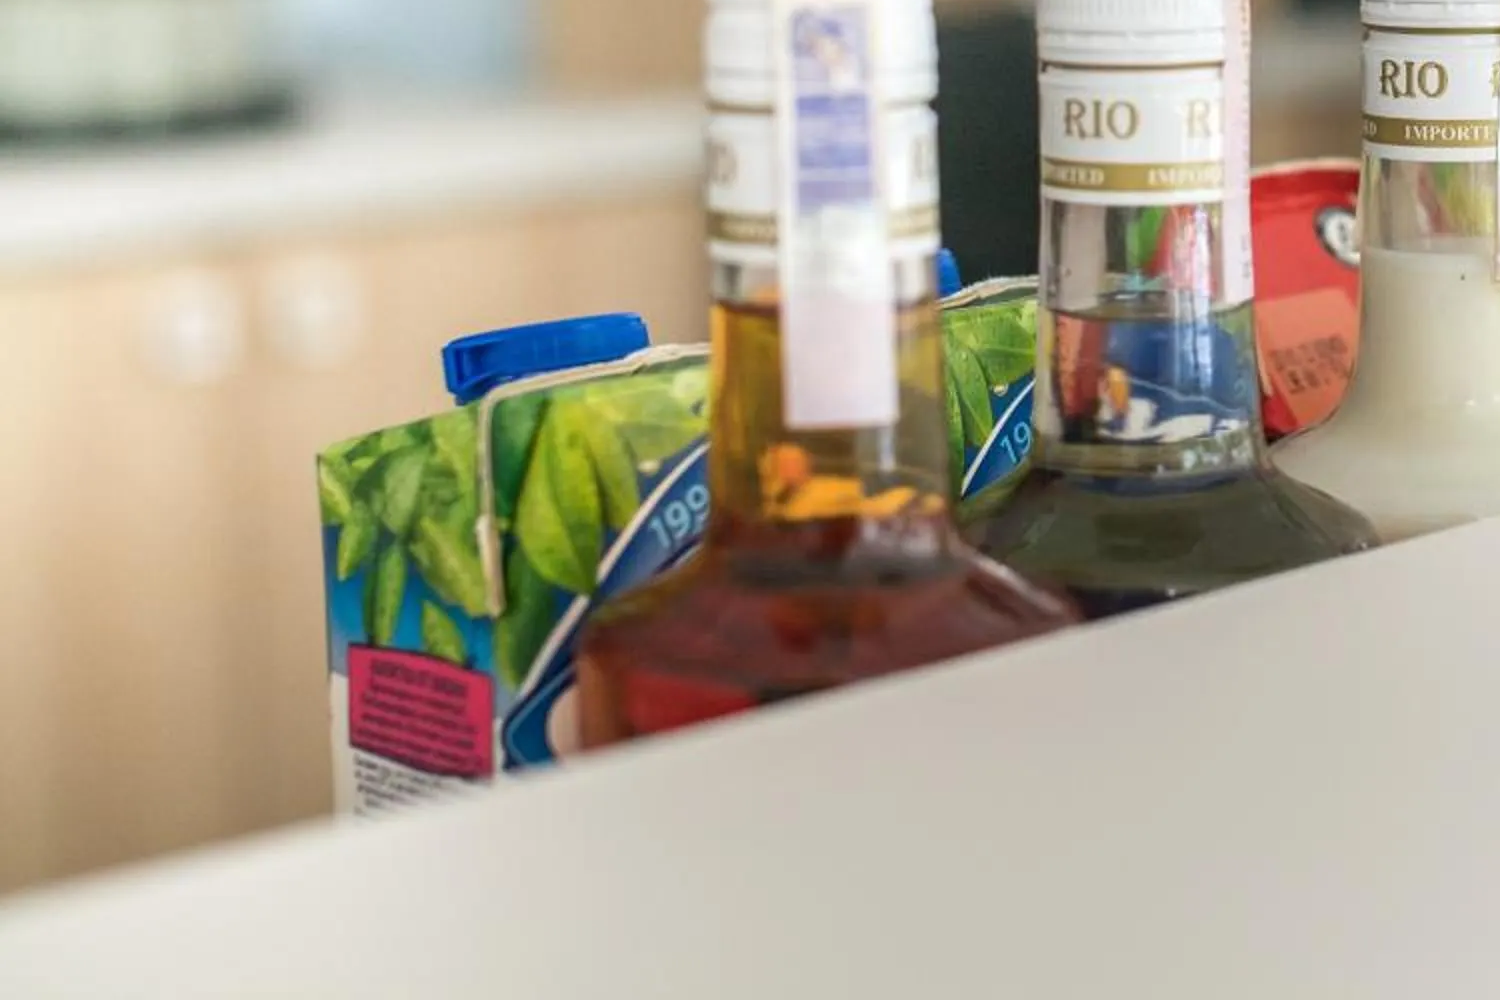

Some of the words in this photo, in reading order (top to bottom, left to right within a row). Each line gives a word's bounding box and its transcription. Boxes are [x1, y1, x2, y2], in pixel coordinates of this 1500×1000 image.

[1379, 59, 1449, 99] RIO
[1063, 97, 1139, 140] RIO
[1000, 421, 1033, 465] 19
[649, 484, 711, 549] 199
